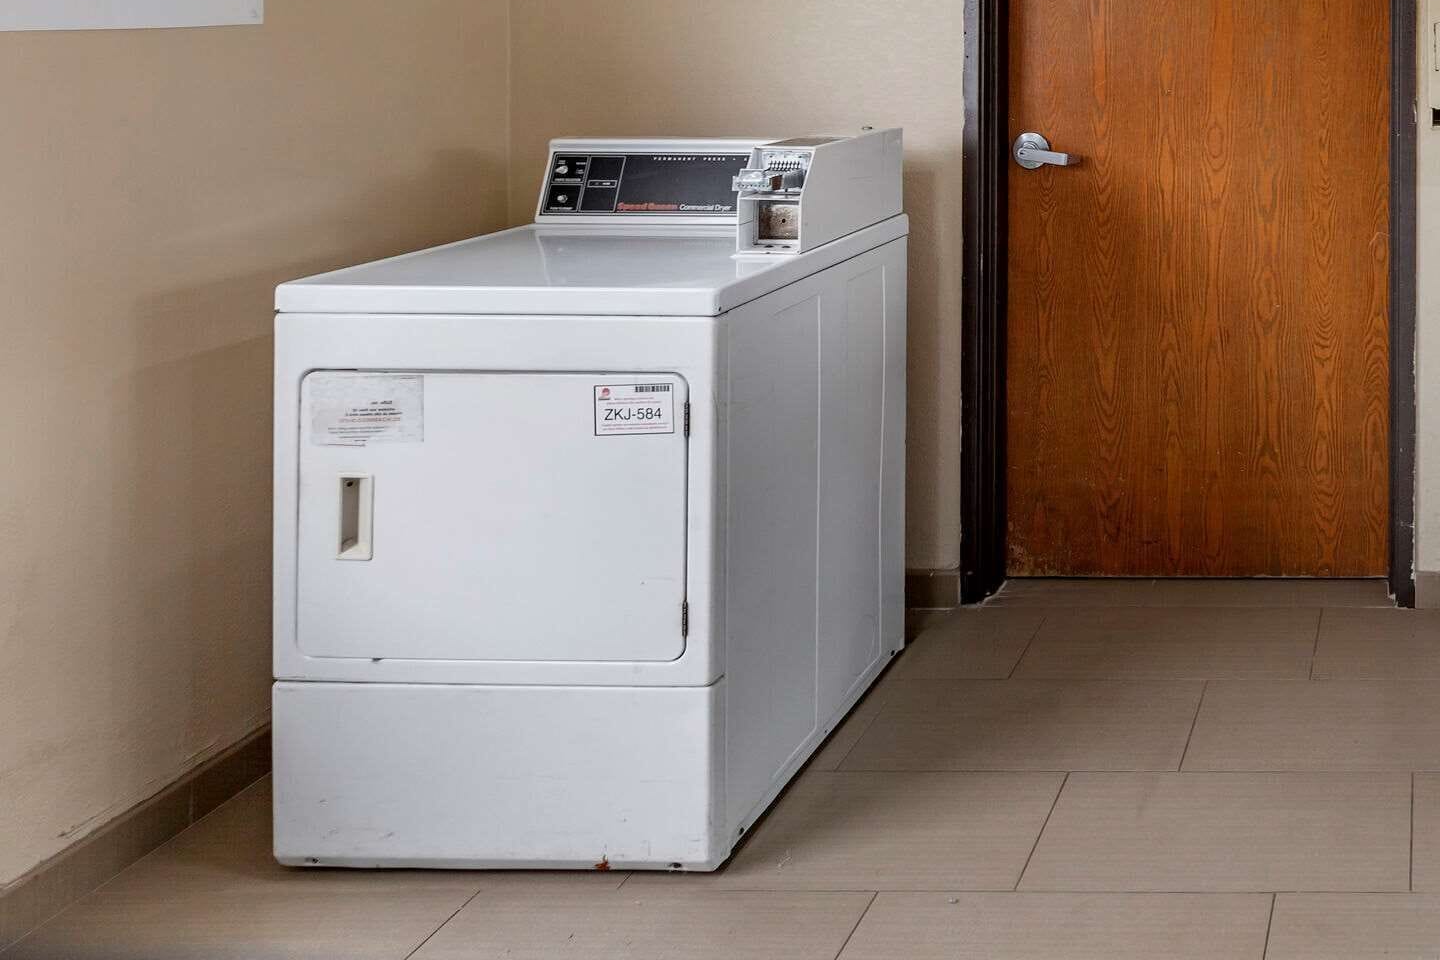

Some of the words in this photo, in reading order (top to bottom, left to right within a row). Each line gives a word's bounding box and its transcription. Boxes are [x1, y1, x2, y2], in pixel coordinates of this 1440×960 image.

[680, 203, 714, 211] Commercial
[714, 204, 733, 213] Dryer
[604, 408, 663, 421] ZKJ-584
